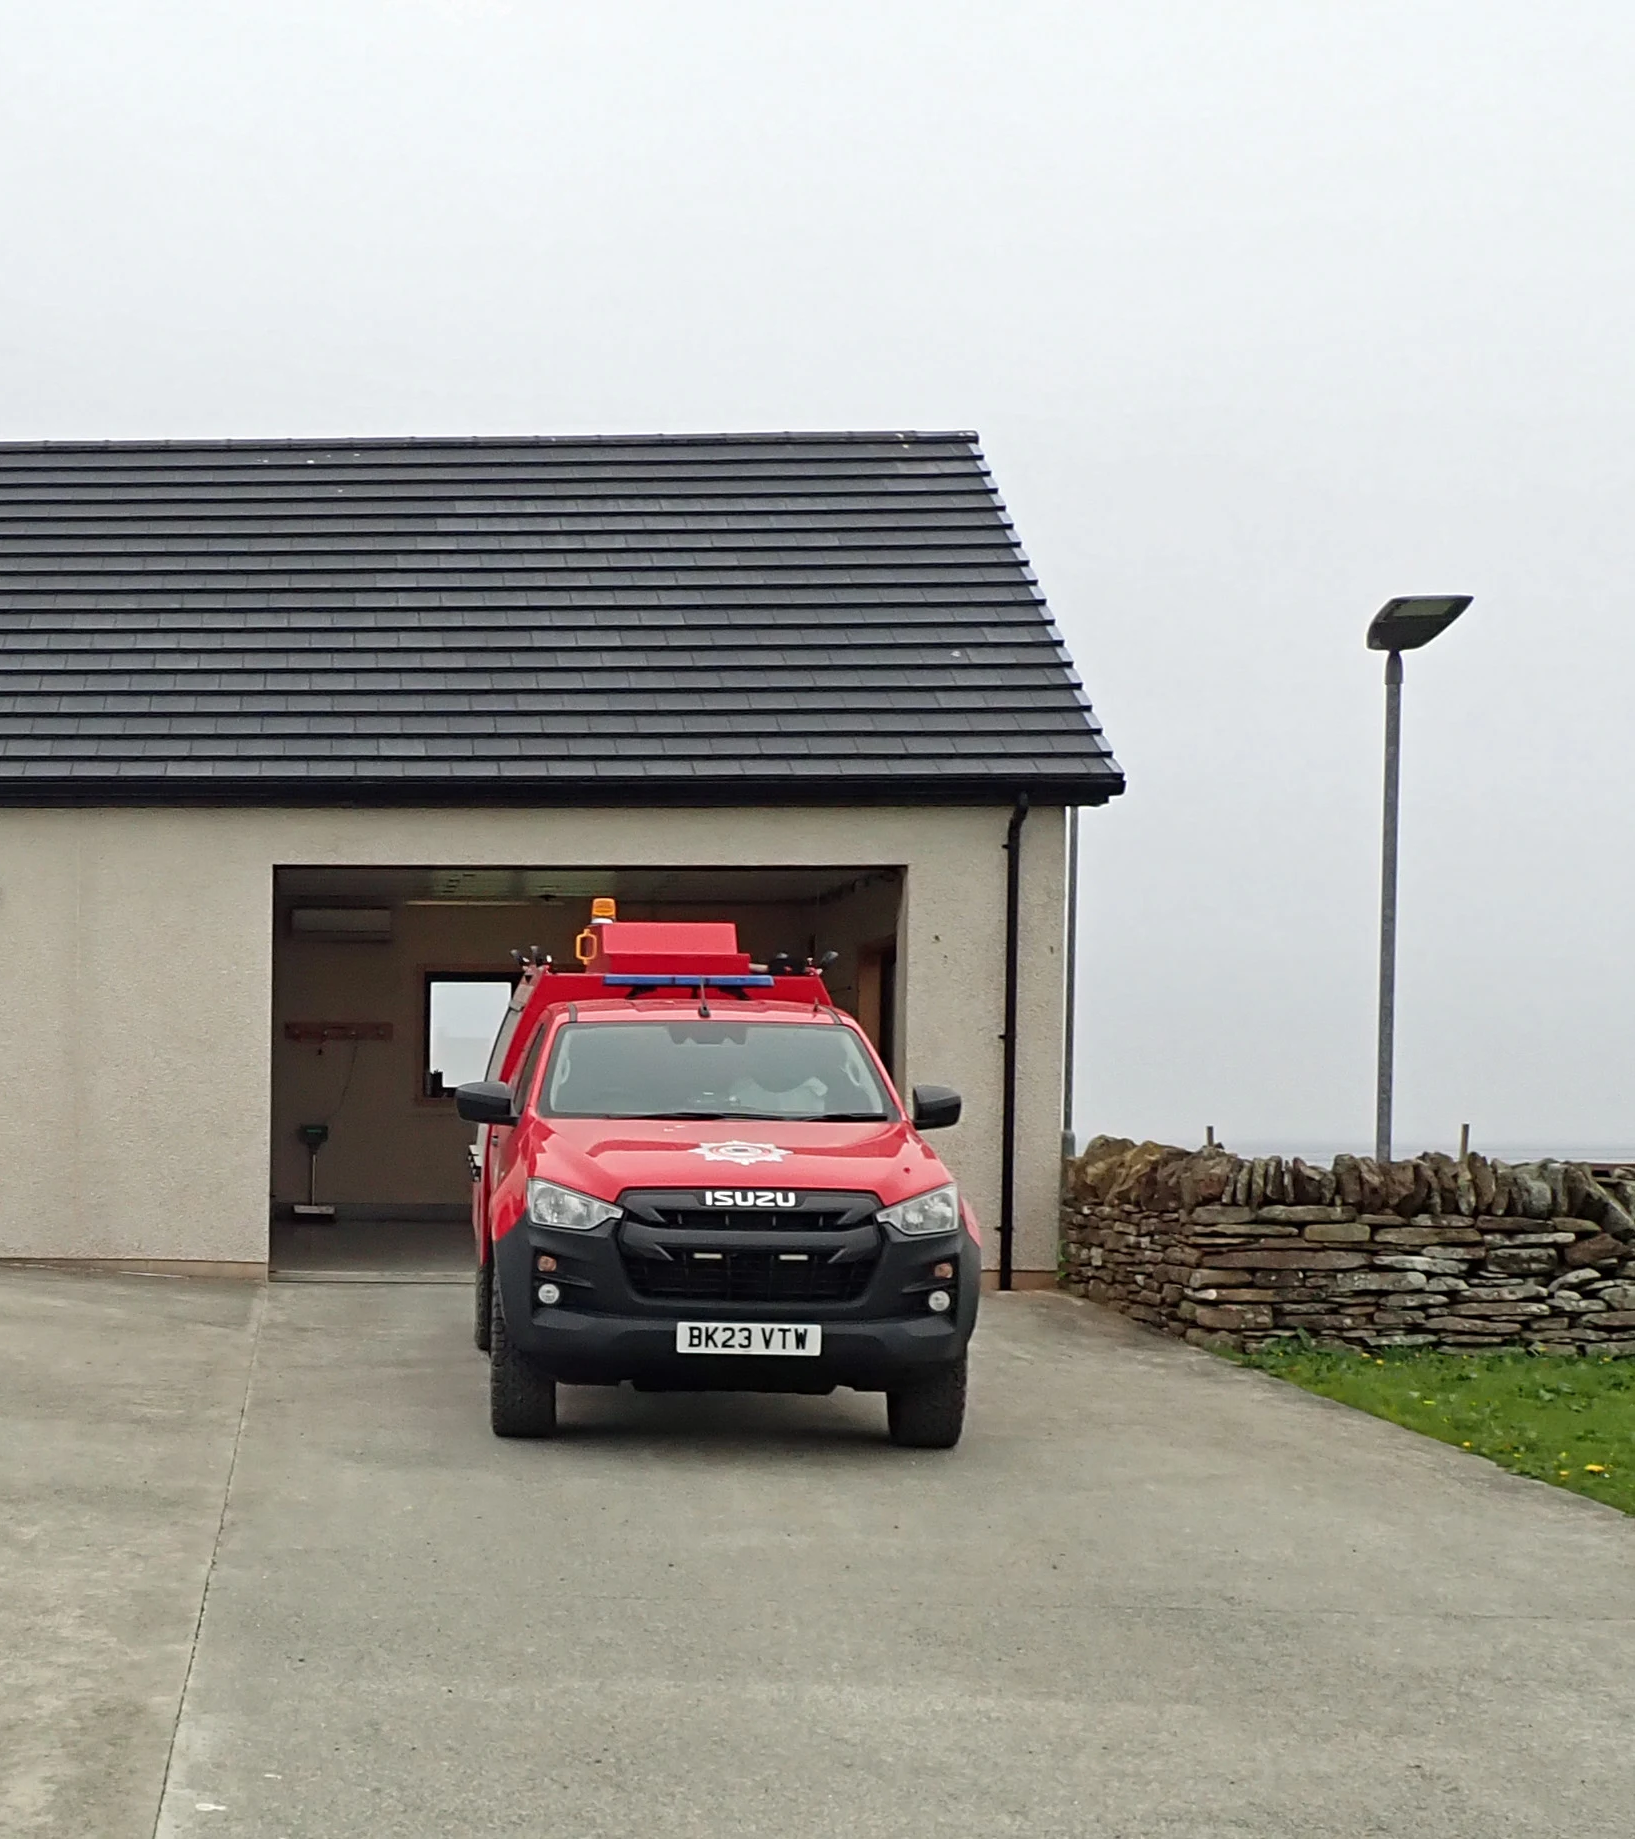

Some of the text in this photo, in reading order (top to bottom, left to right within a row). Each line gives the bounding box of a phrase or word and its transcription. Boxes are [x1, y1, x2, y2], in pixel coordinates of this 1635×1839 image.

[705, 1191, 796, 1207] ISUZU
[688, 1327, 808, 1350] BK23 VTW
